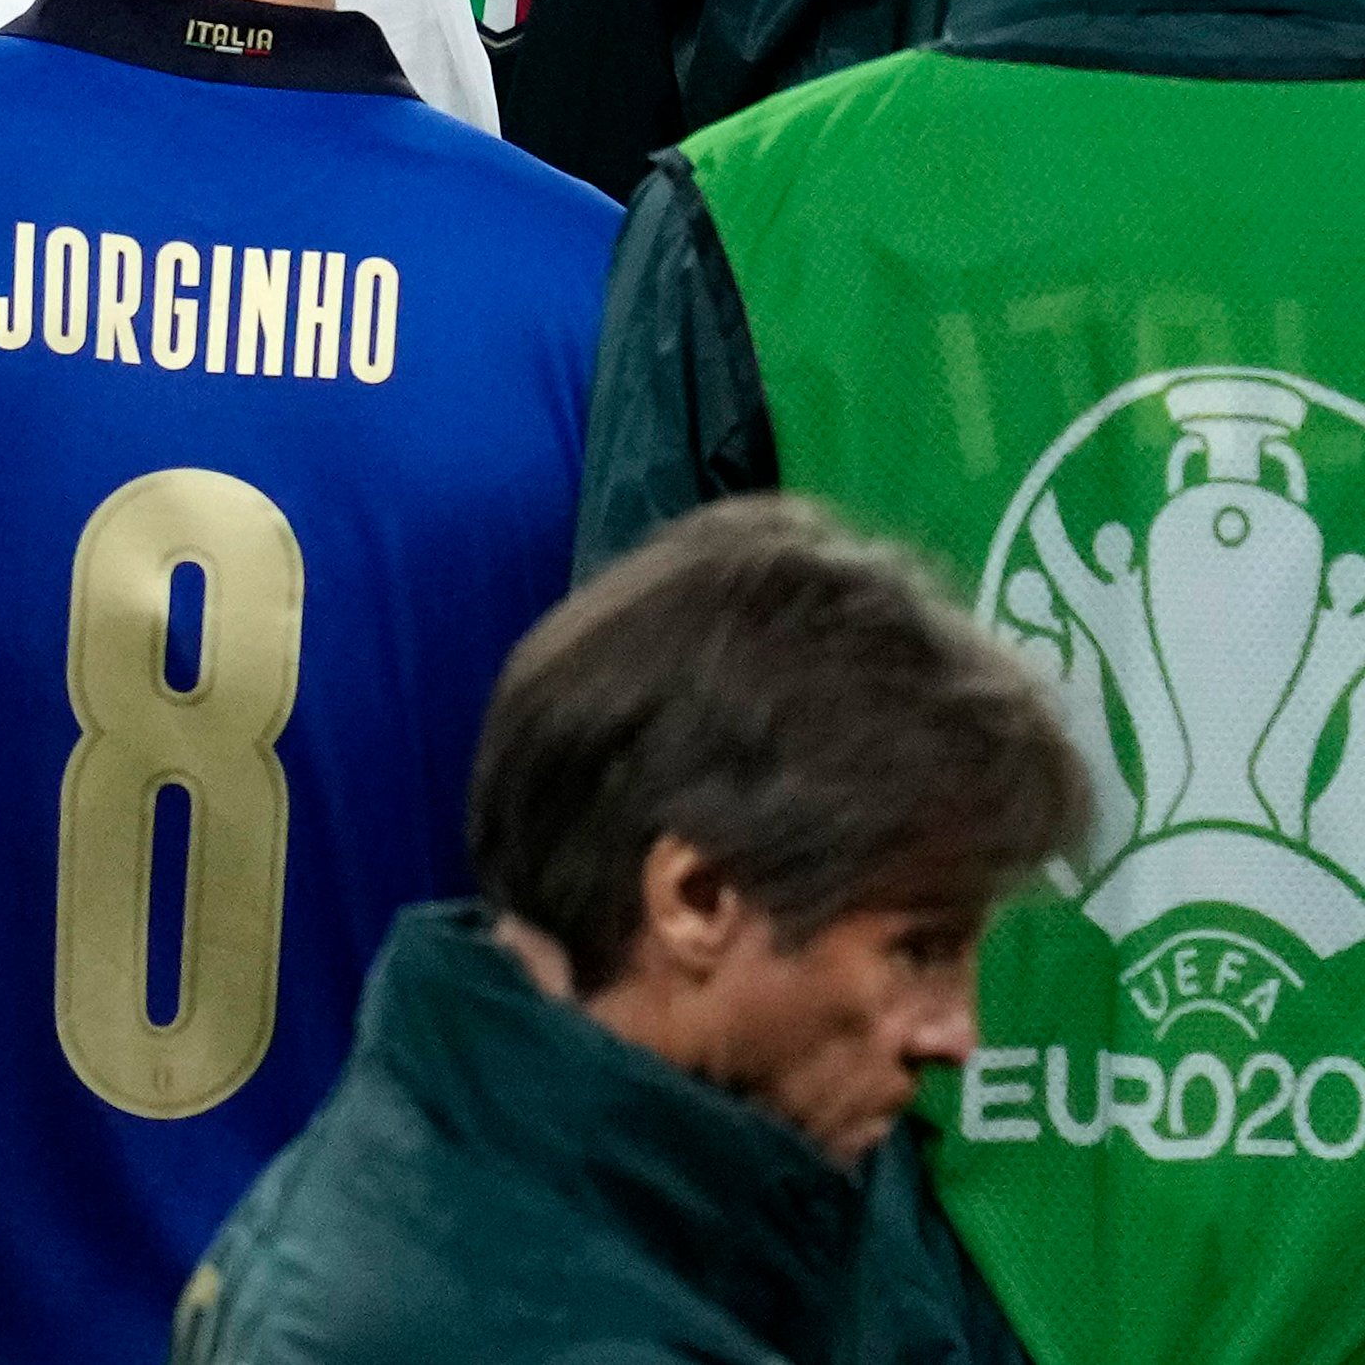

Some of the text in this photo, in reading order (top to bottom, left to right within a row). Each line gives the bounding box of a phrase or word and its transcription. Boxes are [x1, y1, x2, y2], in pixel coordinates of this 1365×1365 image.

[185, 19, 274, 50] ITALIA
[55, 468, 306, 1121] 8
[1130, 947, 1282, 1024] UEFA
